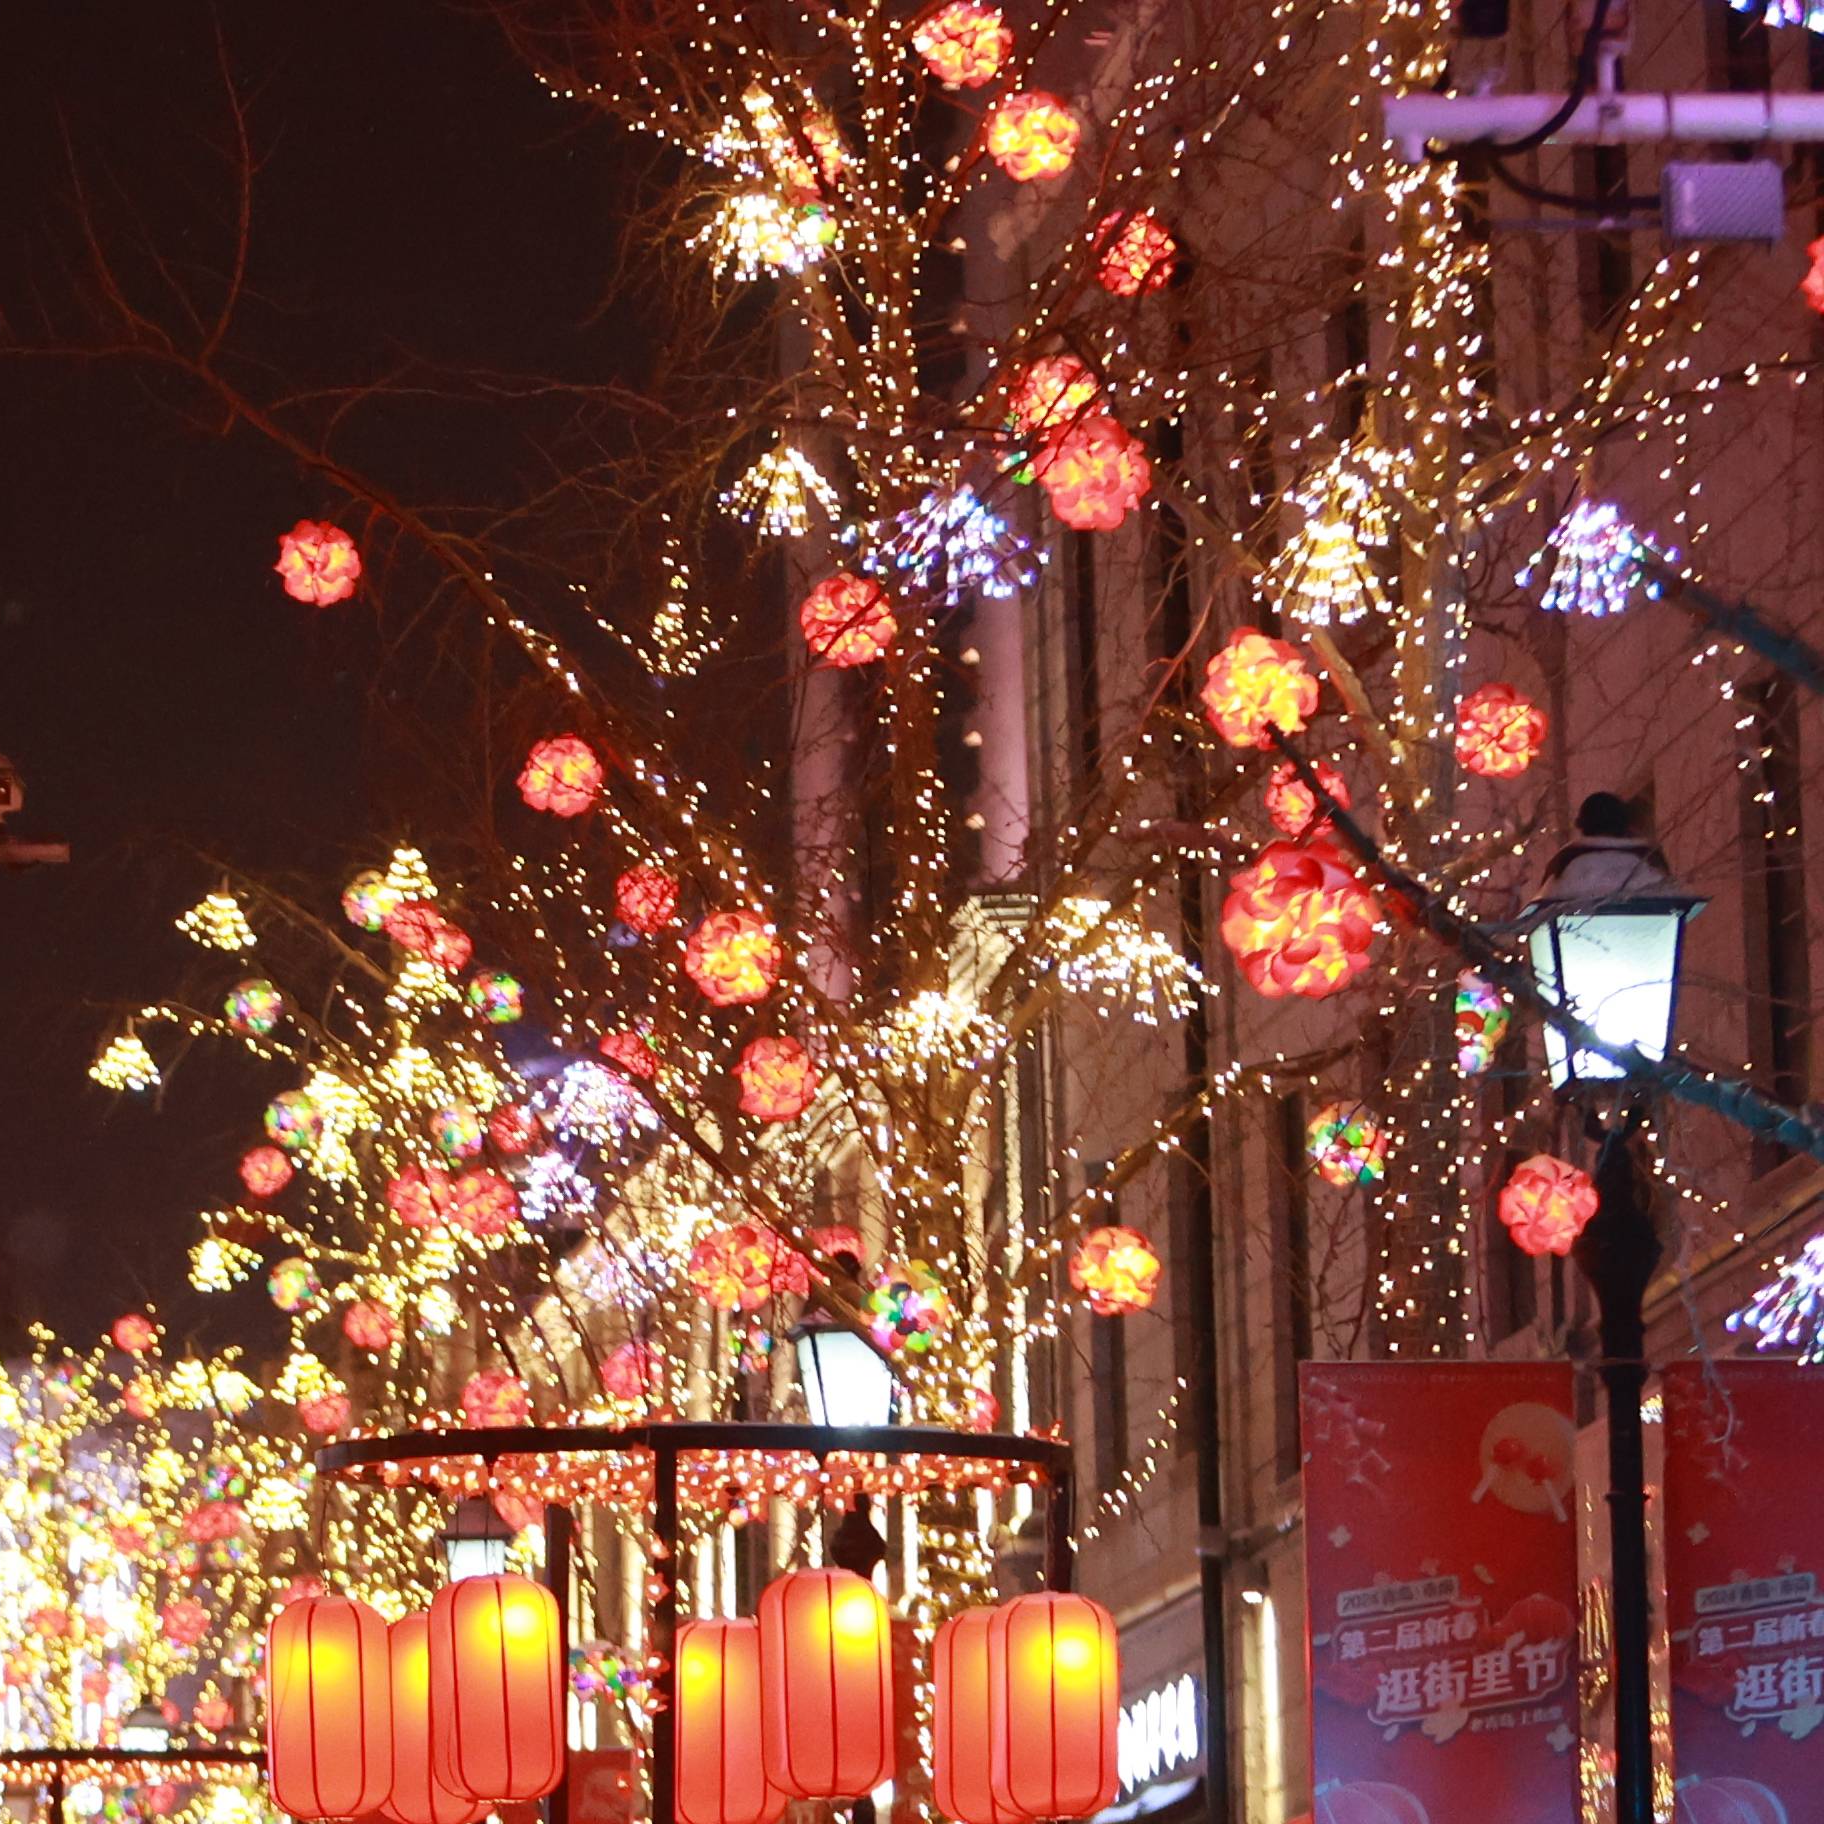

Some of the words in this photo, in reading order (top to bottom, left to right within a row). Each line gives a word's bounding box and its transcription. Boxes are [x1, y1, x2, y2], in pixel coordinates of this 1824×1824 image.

[1339, 1611, 1478, 1660] 第二届新春
[1375, 1638, 1564, 1715] 逛街里节
